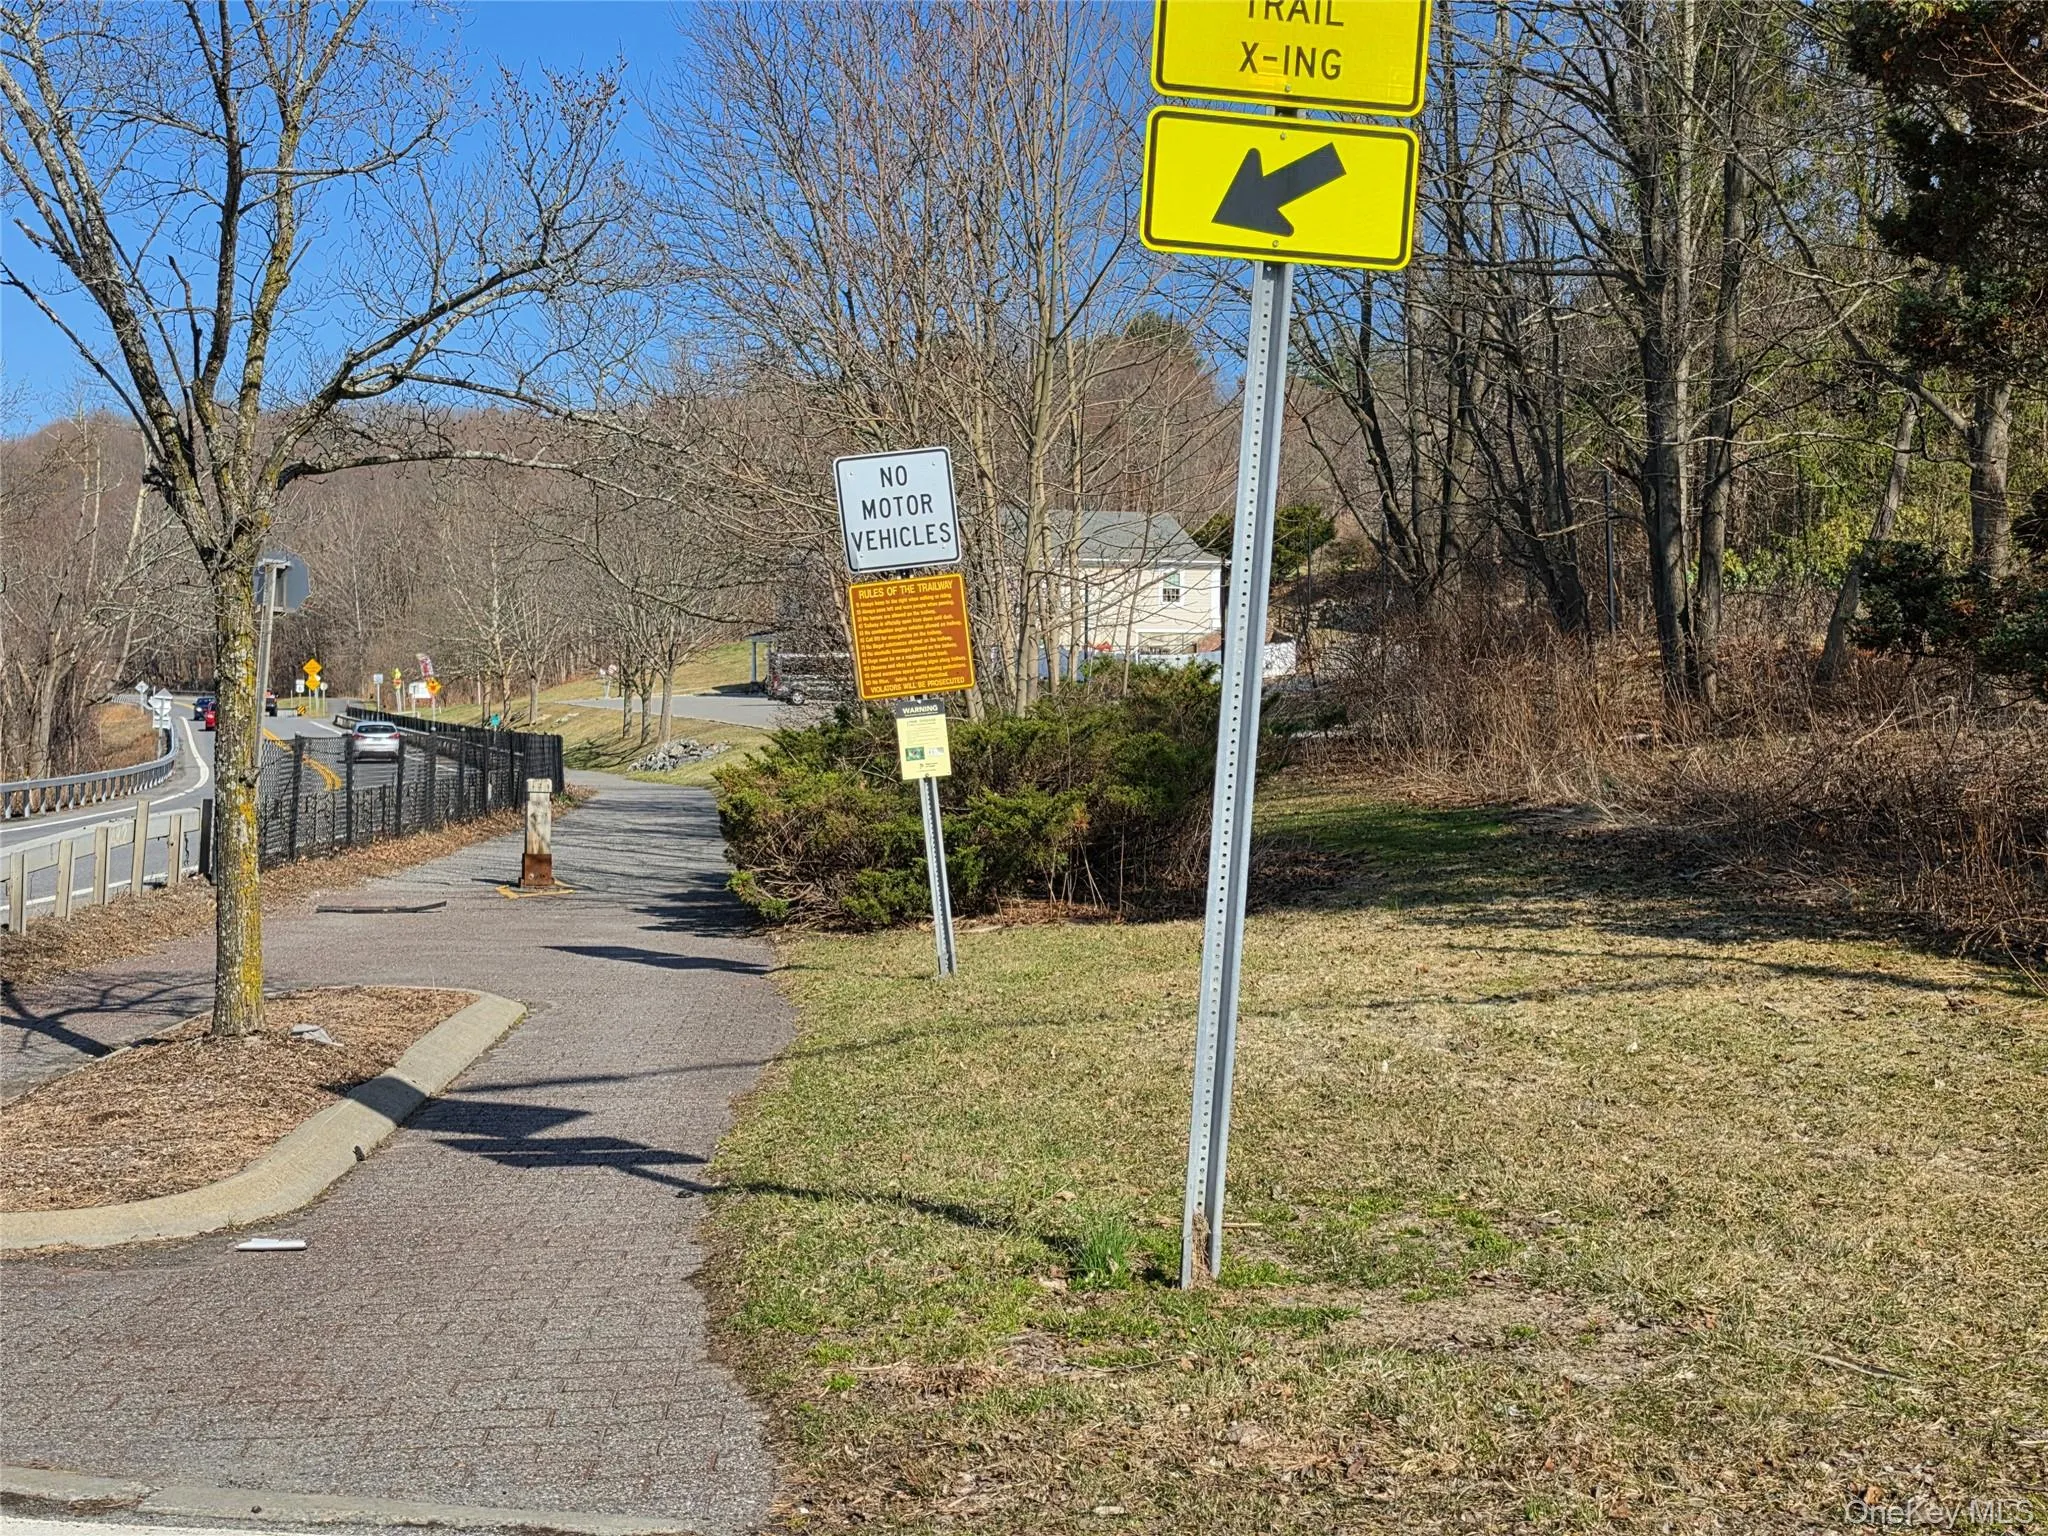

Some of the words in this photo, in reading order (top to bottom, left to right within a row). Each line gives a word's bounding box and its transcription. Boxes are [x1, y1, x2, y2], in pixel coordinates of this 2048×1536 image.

[1239, 41, 1342, 80] X-ING
[880, 465, 908, 488] NO
[862, 494, 934, 520] MOTOR
[850, 522, 952, 552] VEHICLES
[858, 588, 884, 599] RULES
[886, 586, 898, 596] OF
[900, 584, 915, 595] THE
[917, 580, 953, 593] TRAILWAY
[870, 684, 902, 694] VIOLATORS
[927, 676, 965, 687] PROSECUTED
[902, 704, 938, 714] WARNING
